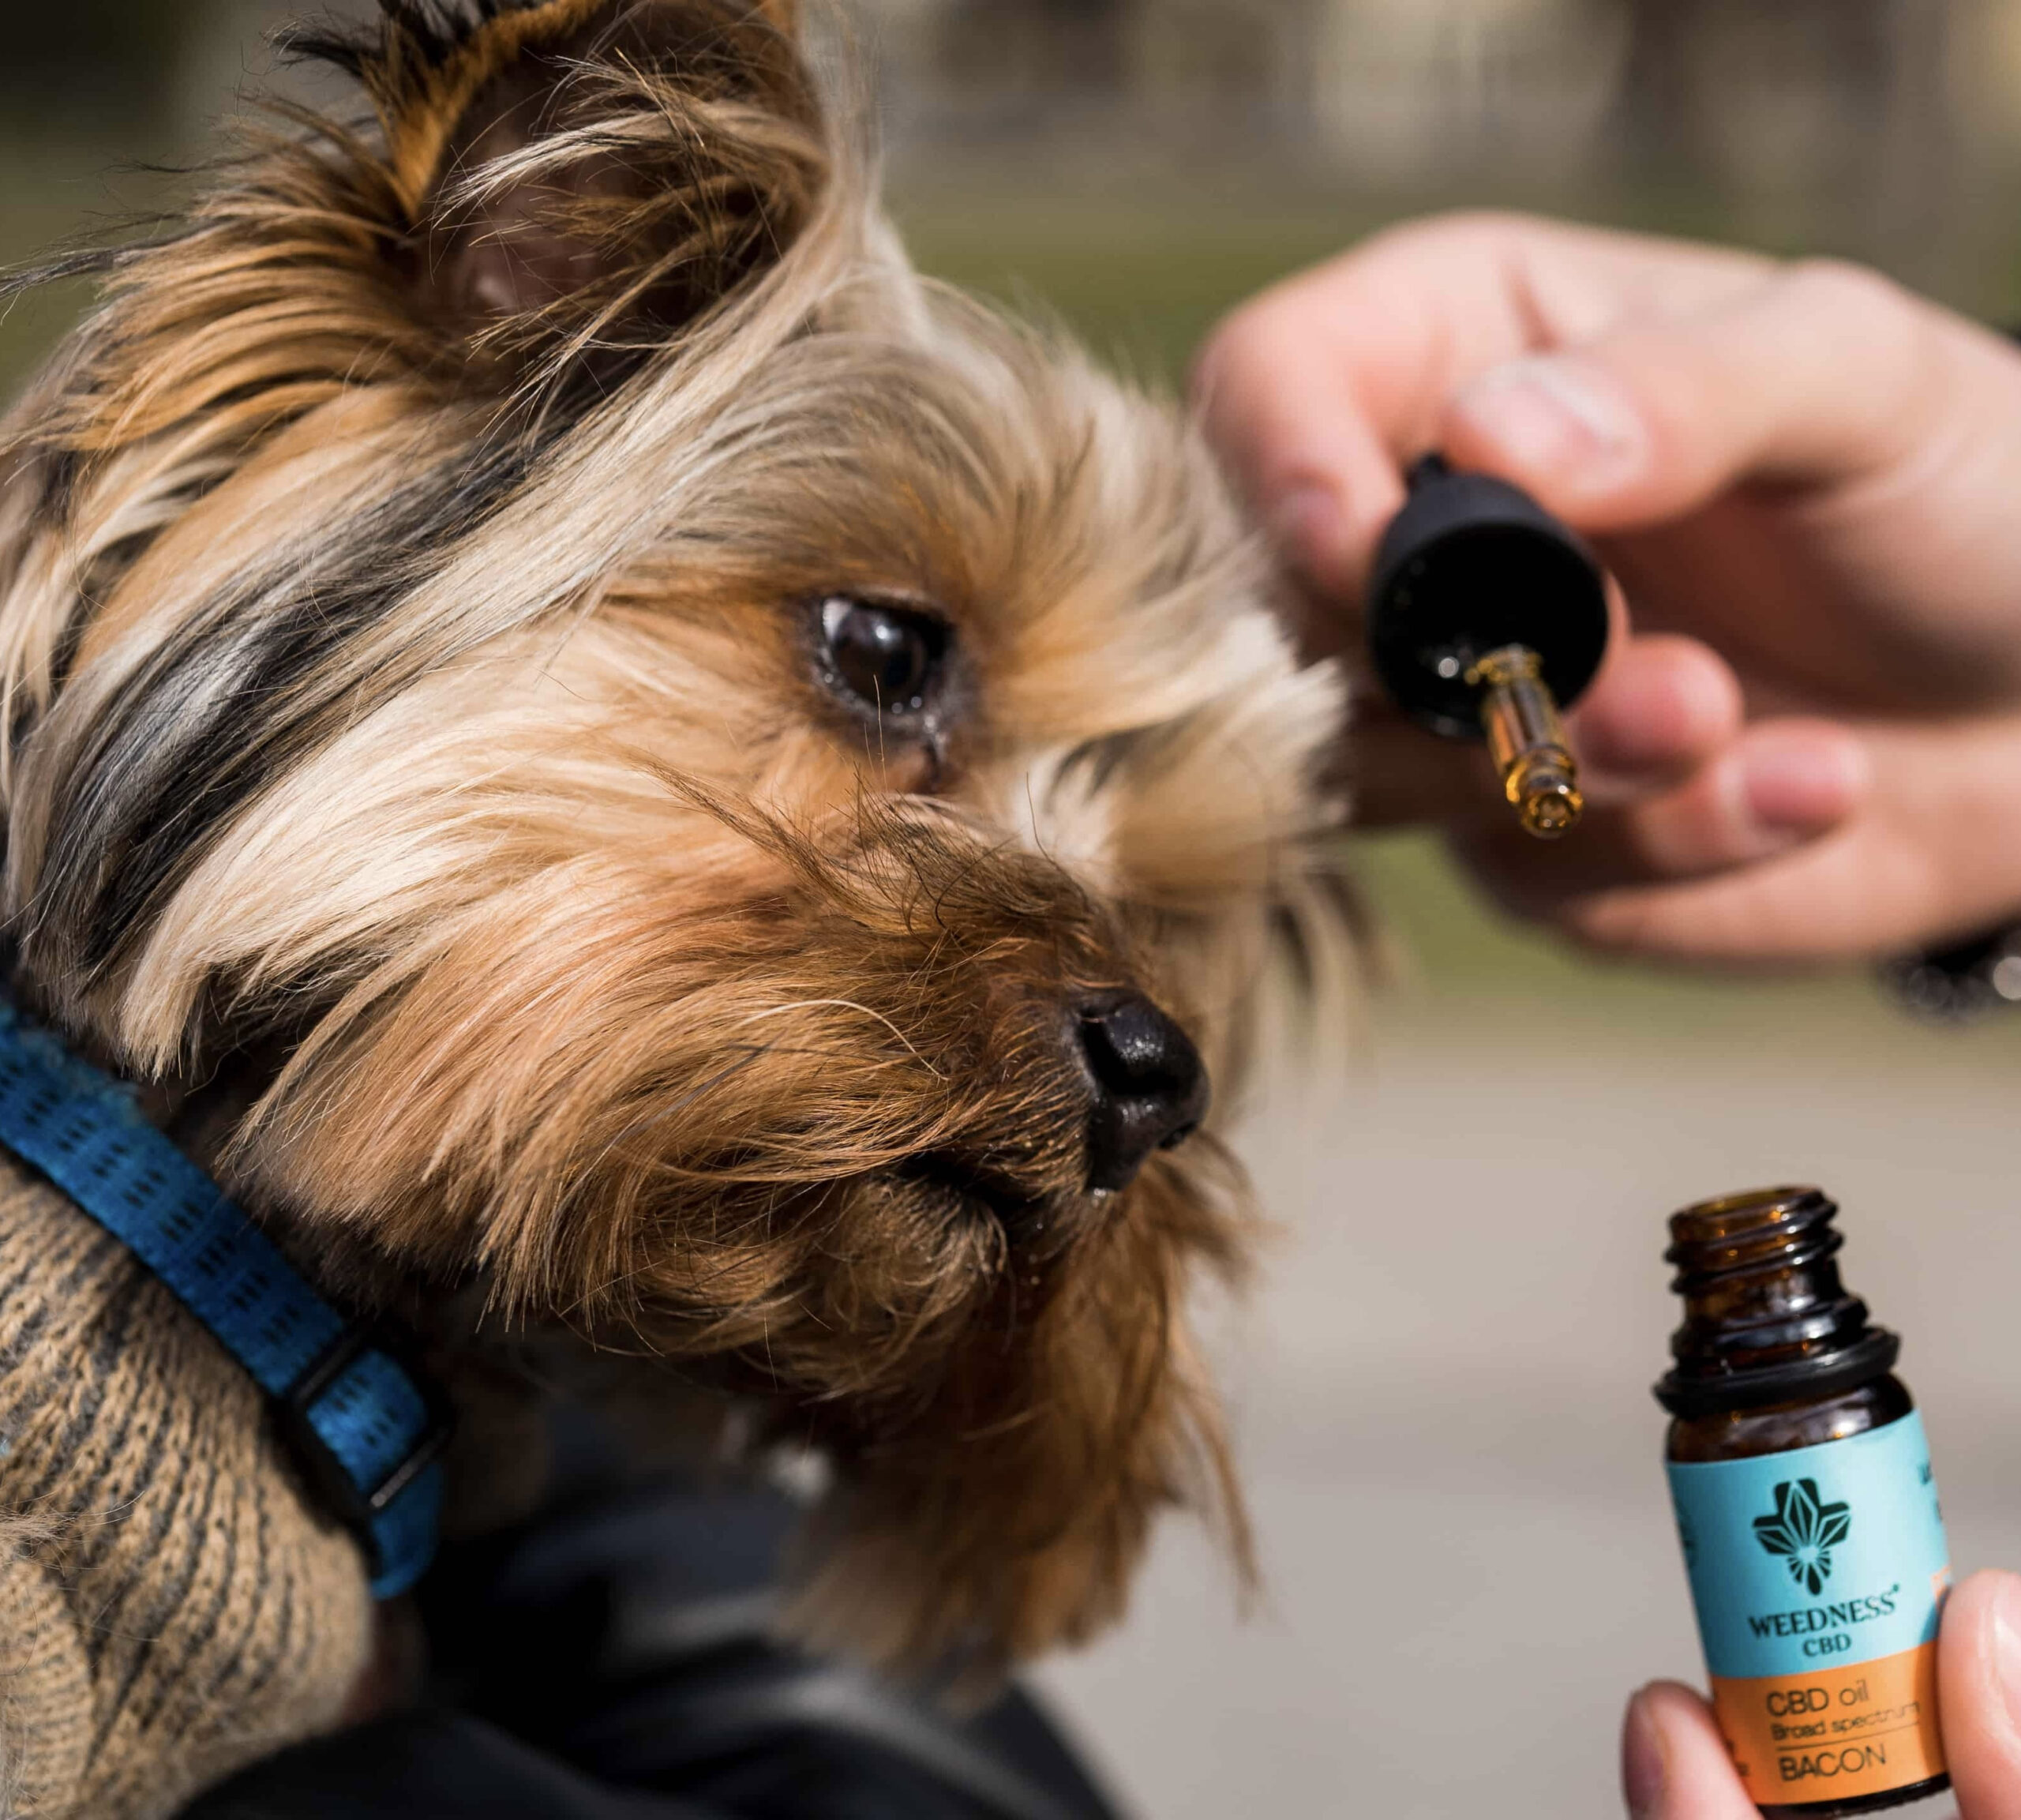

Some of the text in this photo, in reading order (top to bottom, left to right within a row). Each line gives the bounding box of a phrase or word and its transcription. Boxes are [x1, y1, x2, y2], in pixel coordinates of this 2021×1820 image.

[1747, 1590, 1895, 1639] WEEDNESS
[1802, 1633, 1852, 1657] CBD
[1766, 1678, 1870, 1717] CBD oil
[1771, 1701, 1920, 1741] Broad spectrum
[1778, 1743, 1887, 1782] BACON
